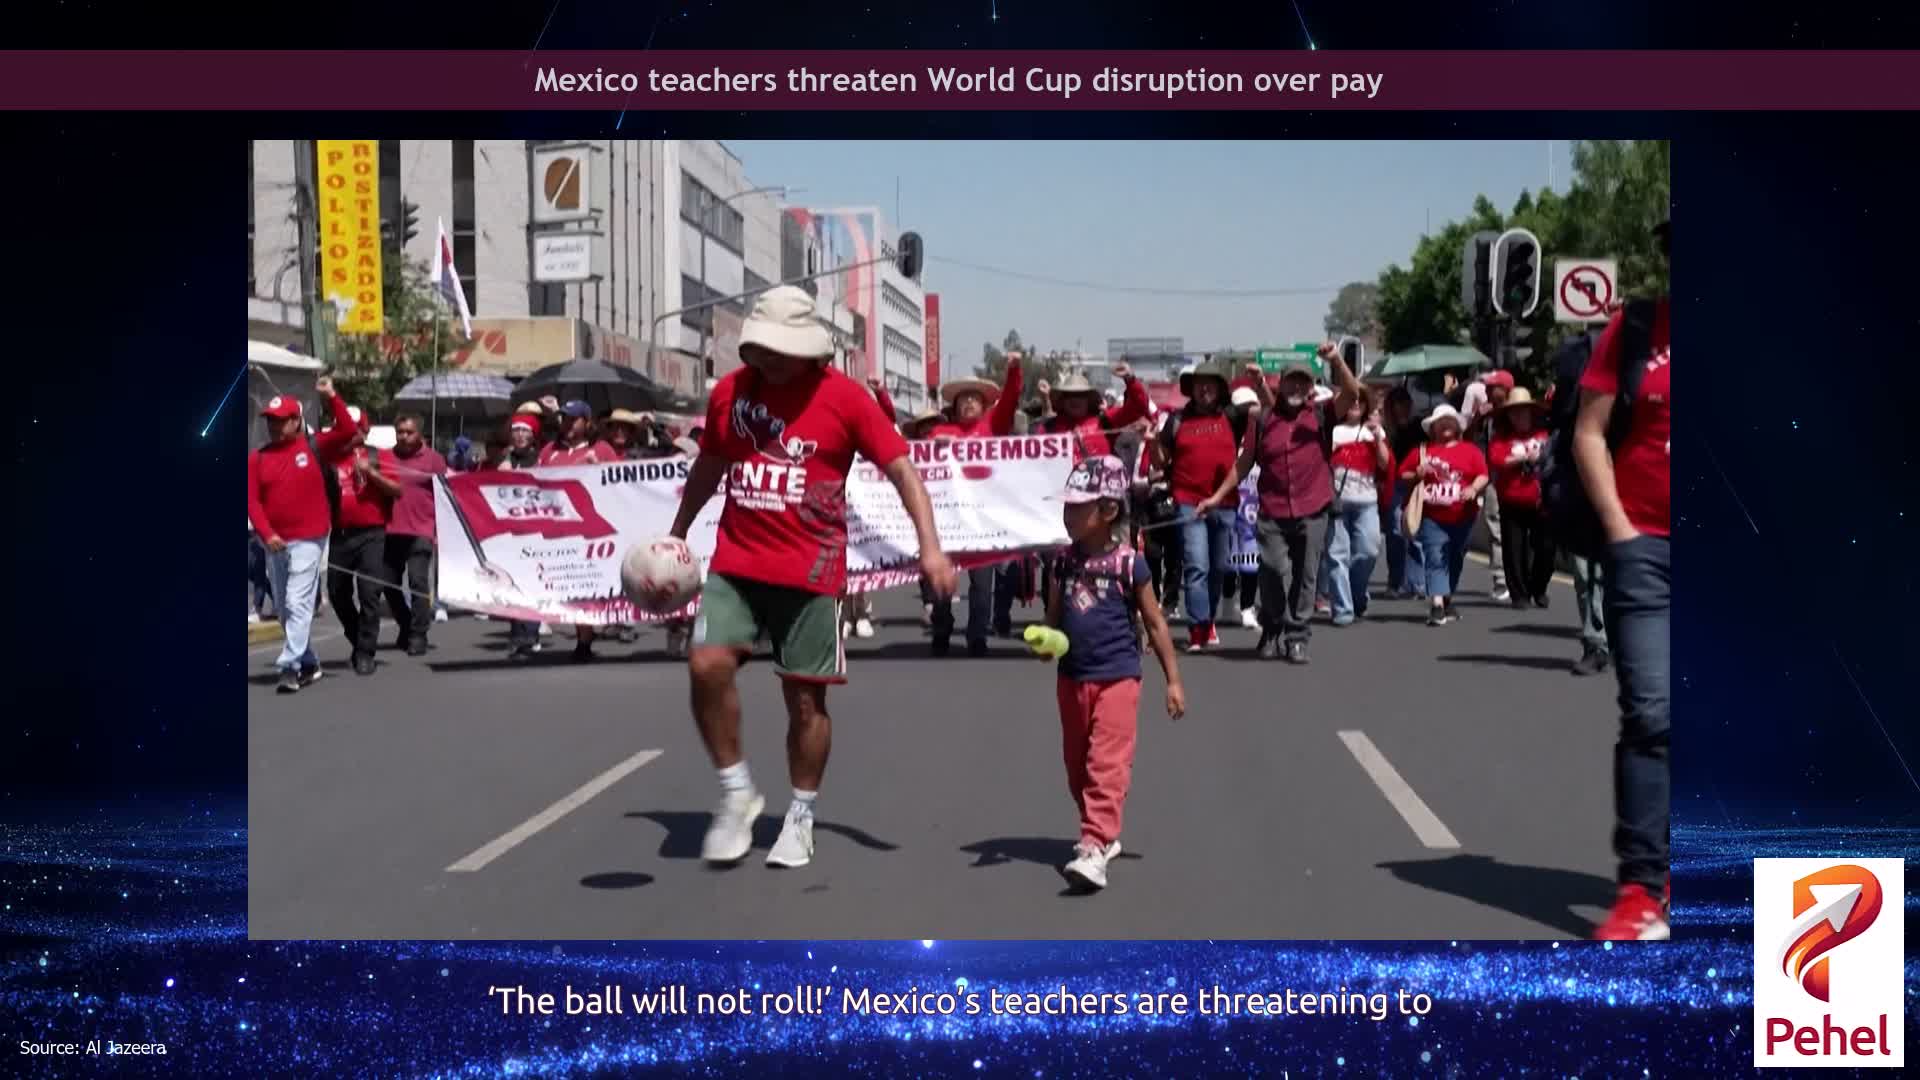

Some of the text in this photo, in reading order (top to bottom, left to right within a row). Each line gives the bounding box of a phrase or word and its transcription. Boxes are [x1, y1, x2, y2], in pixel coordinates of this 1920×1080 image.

[326, 151, 349, 284] POLLOS
[352, 143, 377, 323] ROSTIZADOS
[909, 437, 1068, 464] NCEREMOS!
[730, 461, 807, 496] CNTE
[585, 540, 615, 559] 10
